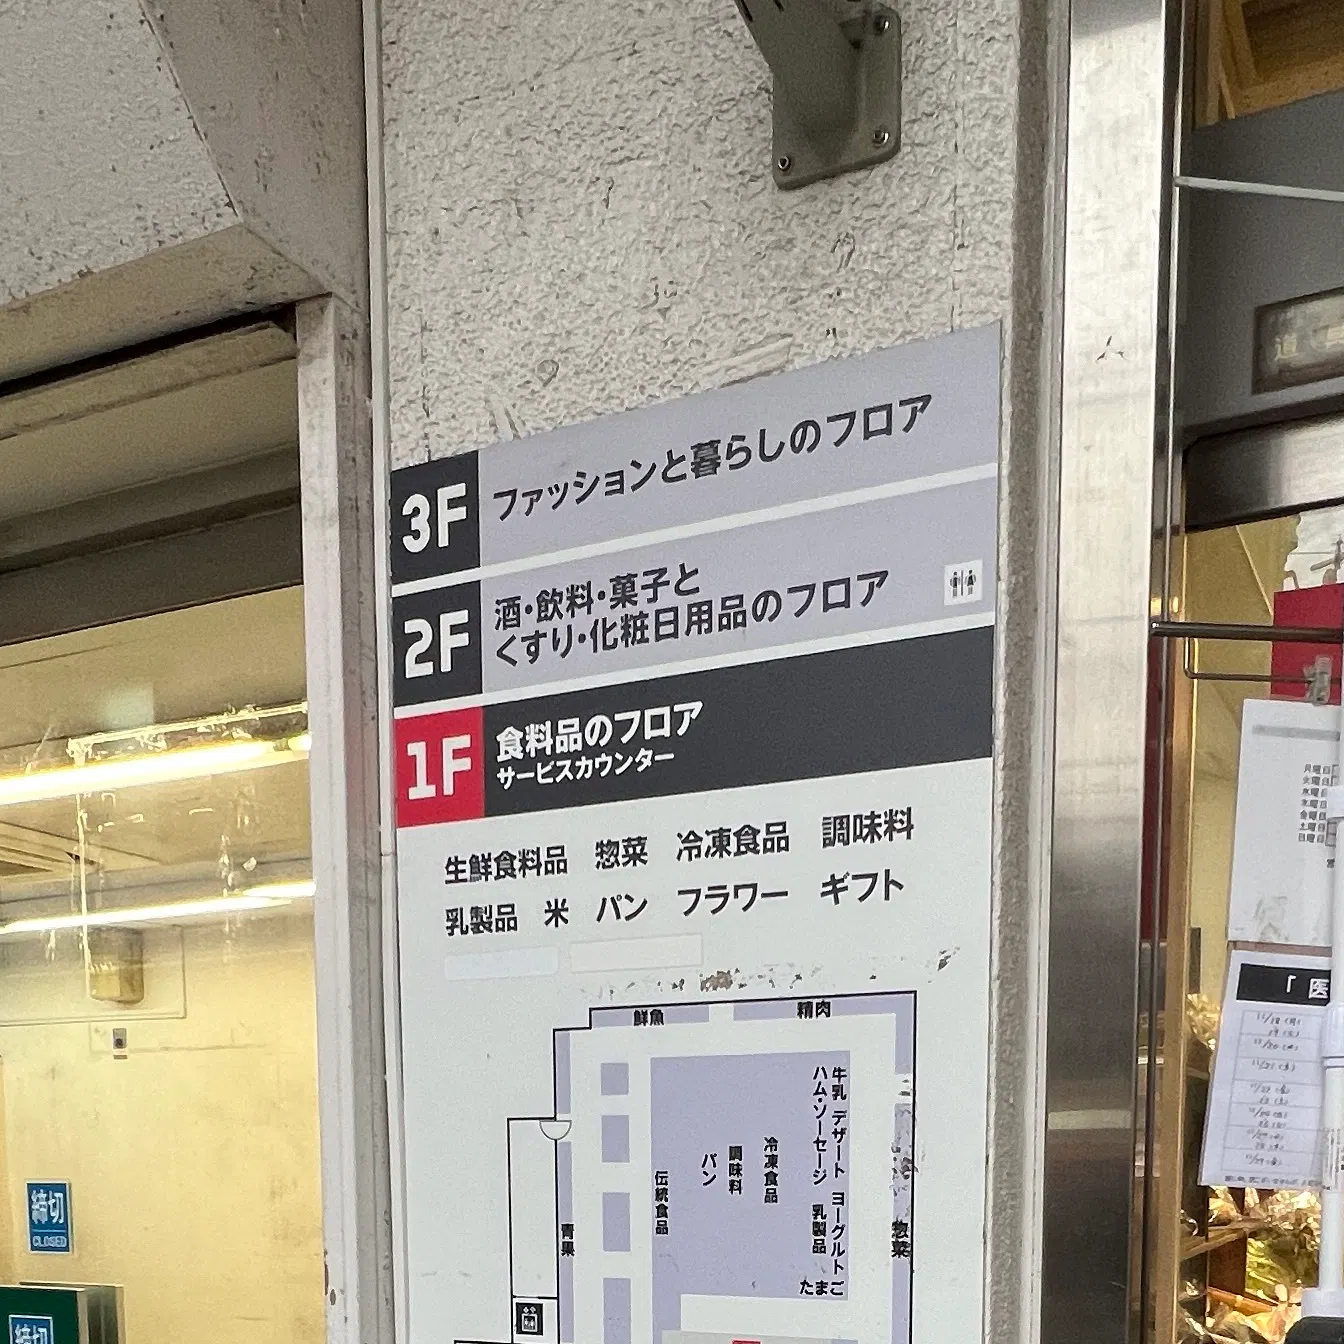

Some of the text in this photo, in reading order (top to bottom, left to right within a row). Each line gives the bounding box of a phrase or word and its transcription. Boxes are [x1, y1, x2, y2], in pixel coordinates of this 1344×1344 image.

[493, 393, 934, 522] ファッションと暮らしのフロア
[401, 484, 468, 554] 3F
[494, 562, 702, 631] 酒・飲料・菓子と
[495, 569, 890, 669] くすり・化粧日用品のフロア
[403, 609, 470, 680] 2F
[496, 700, 705, 763] 食料品のフロア
[406, 735, 473, 800] 1F
[496, 748, 675, 789] サービスカウンター
[445, 807, 915, 885] 生鮮食料品 惣菜 冷凍食品 調味料
[445, 868, 905, 938] 乳製品 米 パン フラワー ギフト
[632, 1007, 666, 1027] 鮮魚
[796, 1000, 832, 1020] 精肉
[811, 1066, 829, 1186] ハム・ソーセージ
[701, 1152, 718, 1187] パン
[728, 1145, 743, 1196] 調味料
[763, 1136, 779, 1204] 冷凍食品
[830, 1066, 848, 1276] 牛乳 デザート ヨーグルト
[654, 1170, 669, 1236] 伝統食品
[32, 1234, 68, 1248] CLOSED
[560, 1222, 576, 1258] 青果
[798, 1279, 845, 1297] たまご
